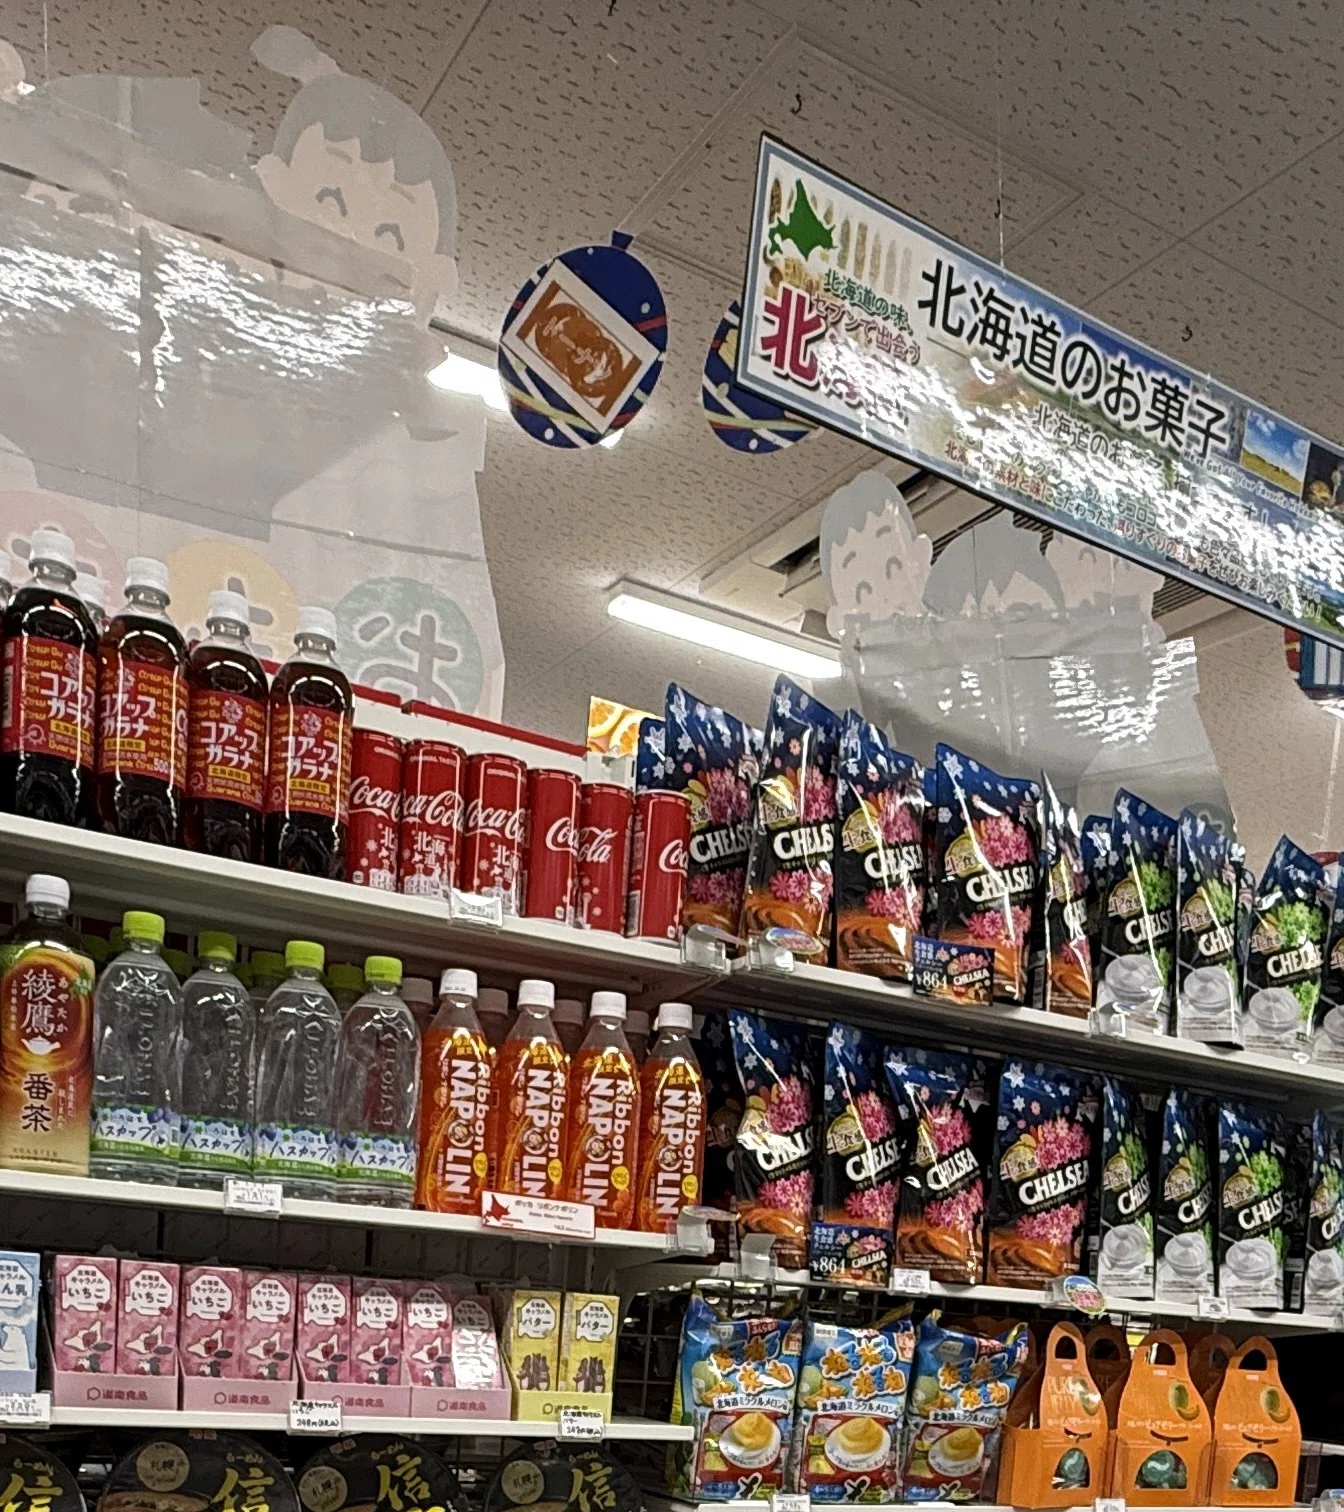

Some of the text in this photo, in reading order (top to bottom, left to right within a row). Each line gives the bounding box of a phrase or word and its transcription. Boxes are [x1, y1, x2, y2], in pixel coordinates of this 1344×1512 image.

[918, 258, 1230, 461] 北海道のお菓子
[201, 721, 259, 753] コアップ
[205, 744, 256, 770] ガラナ
[448, 1057, 479, 1204] NAPOLIN
[474, 1060, 492, 1152] Ribbon
[547, 1070, 566, 1159] Ribbon
[581, 1075, 615, 1207] NAPOLIN
[611, 1077, 634, 1166] Ribbon
[680, 1089, 701, 1176] Ribbon
[1018, 1158, 1091, 1207] CHELSEA
[67, 1286, 106, 1300] いちご
[131, 1291, 167, 1304] いちご
[191, 1295, 227, 1310] いちご
